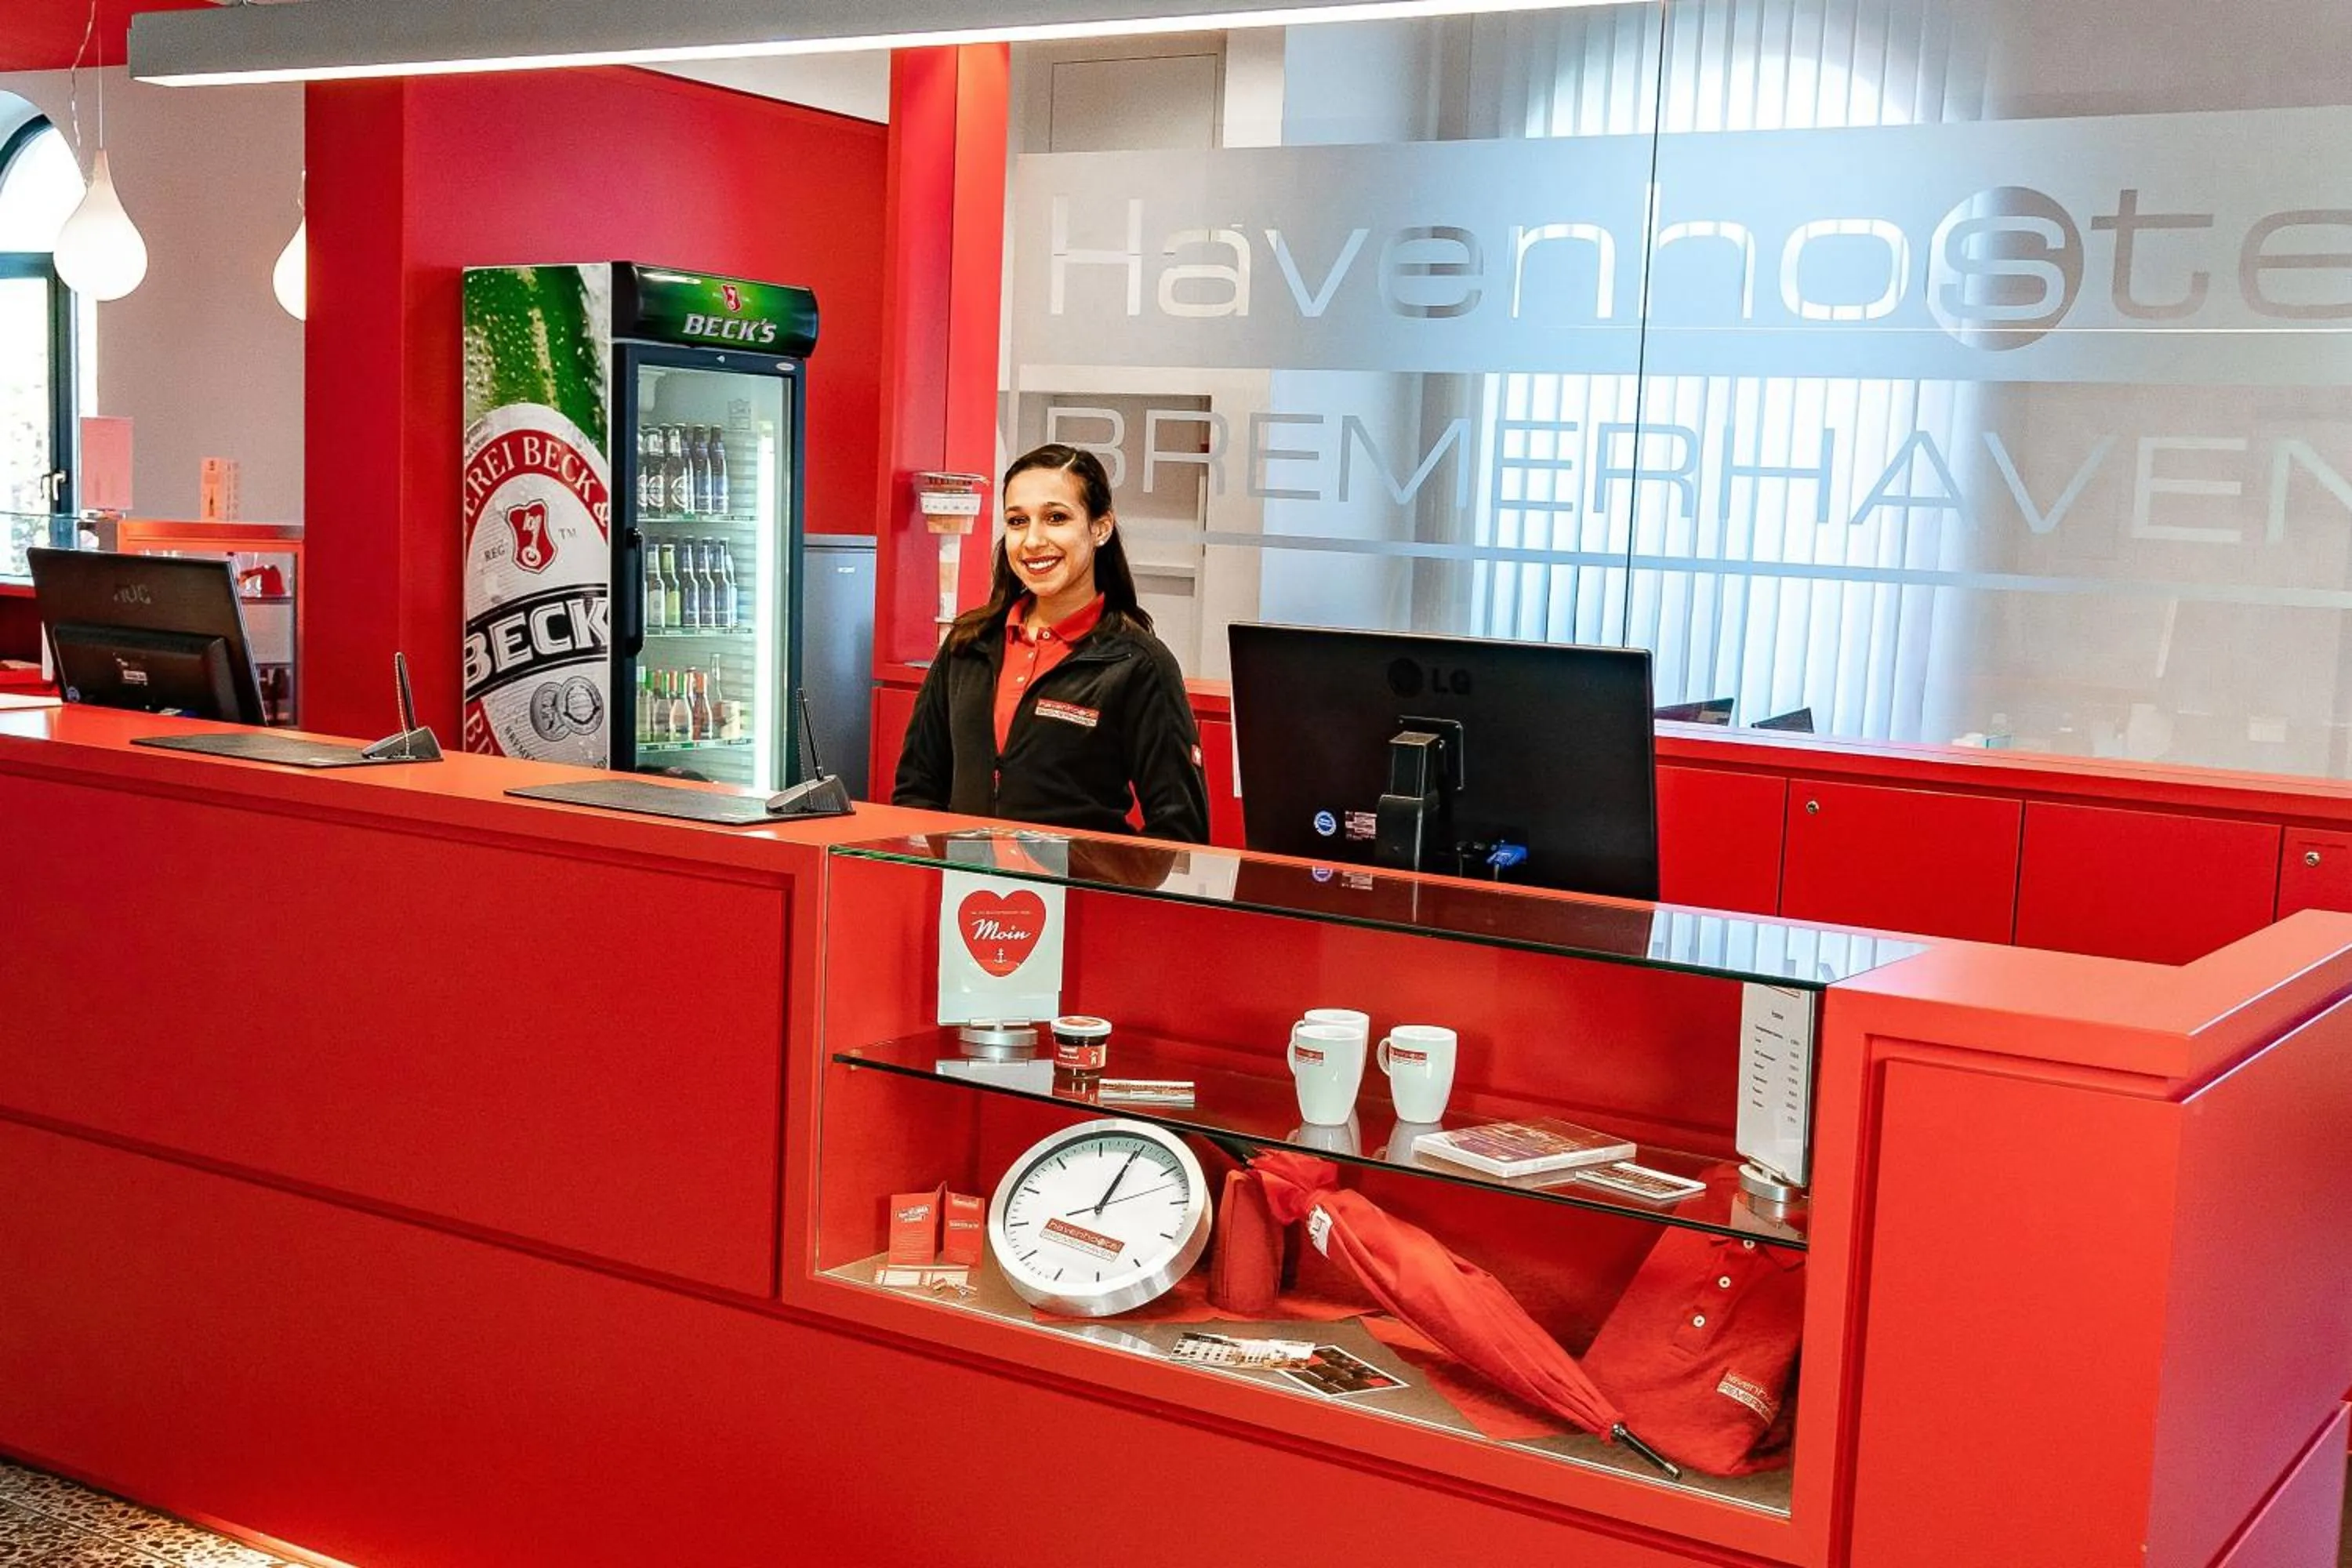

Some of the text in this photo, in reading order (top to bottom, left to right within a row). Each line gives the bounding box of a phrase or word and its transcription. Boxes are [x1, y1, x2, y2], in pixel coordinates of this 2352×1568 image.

[681, 314, 778, 343] BECK'S
[523, 436, 598, 503] BECK
[465, 597, 608, 690] BECK
[1432, 668, 1472, 695] LG
[971, 918, 1032, 940] Moin
